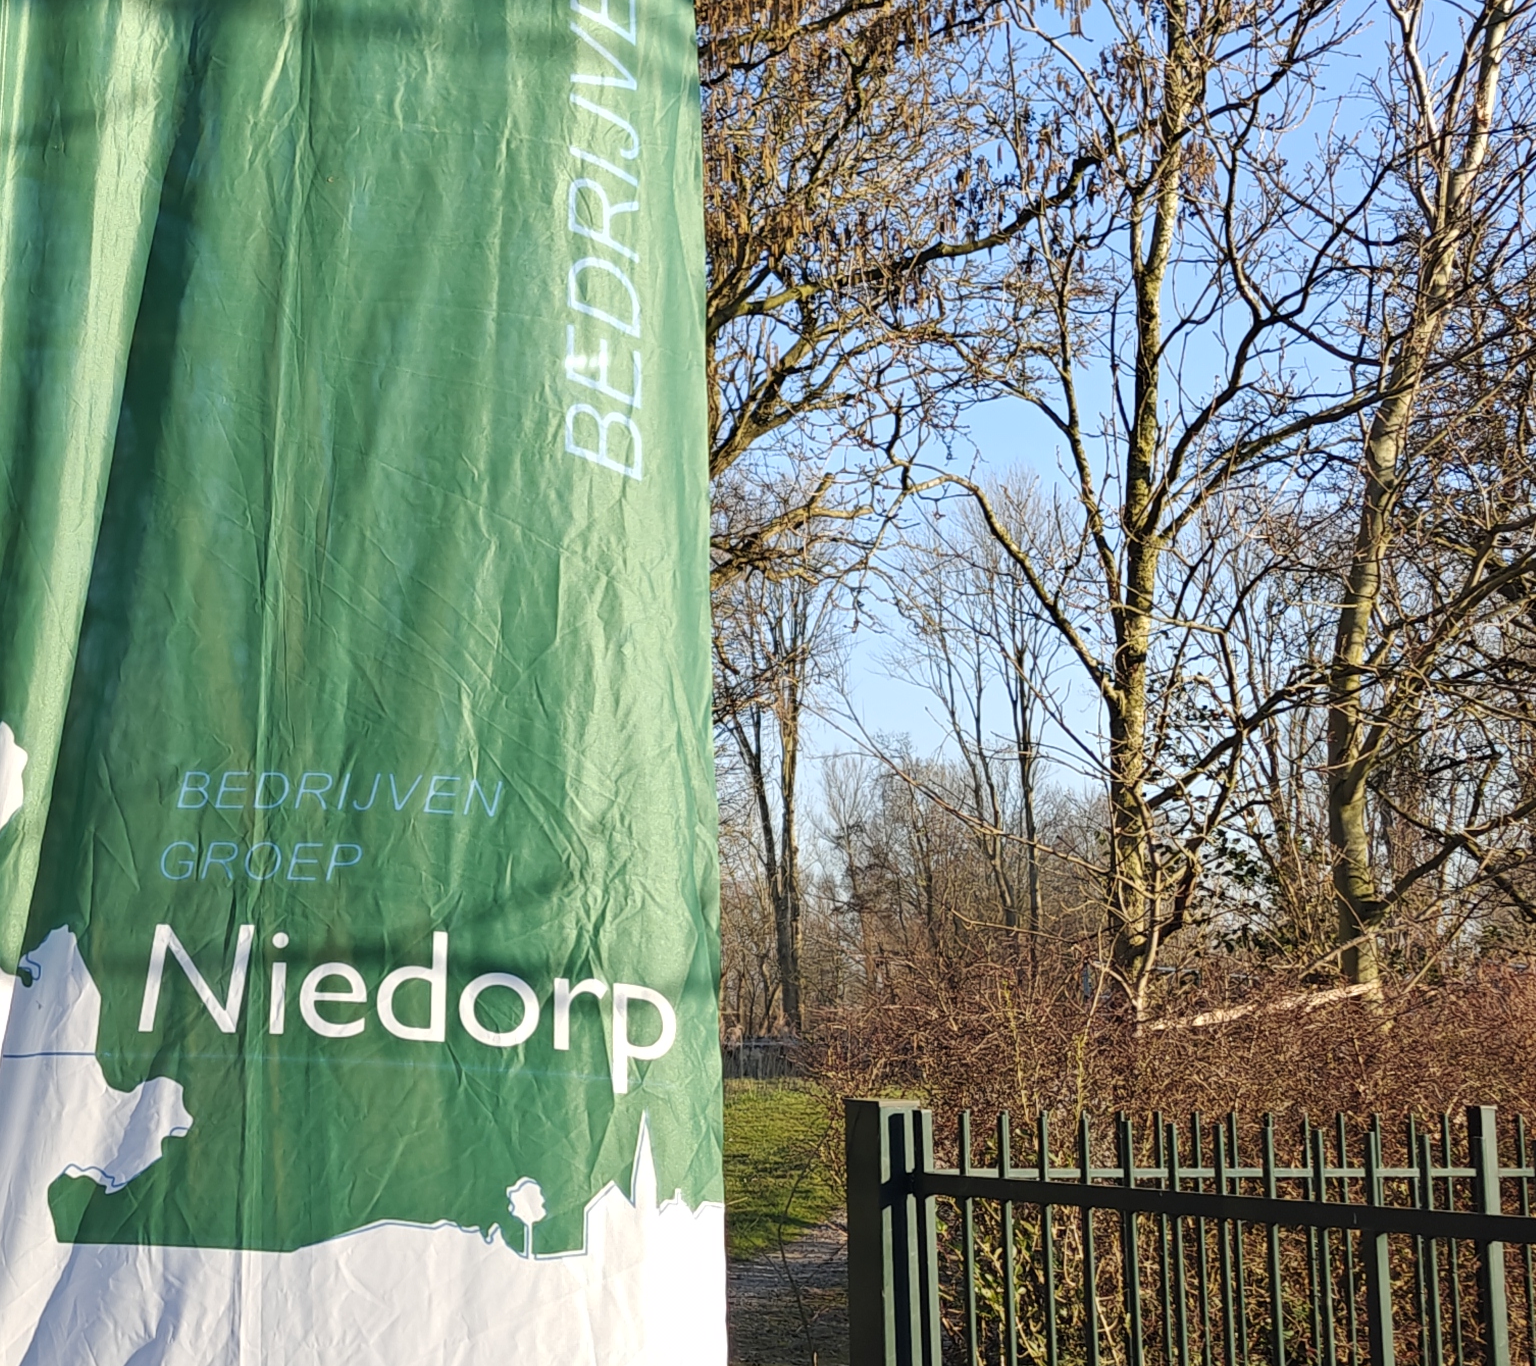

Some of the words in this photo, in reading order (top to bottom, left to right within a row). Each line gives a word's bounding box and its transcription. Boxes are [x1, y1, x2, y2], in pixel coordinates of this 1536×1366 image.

[176, 770, 505, 818] BEDRIJVEN
[160, 840, 363, 882] GROEP
[137, 923, 678, 1095] Niedorp
